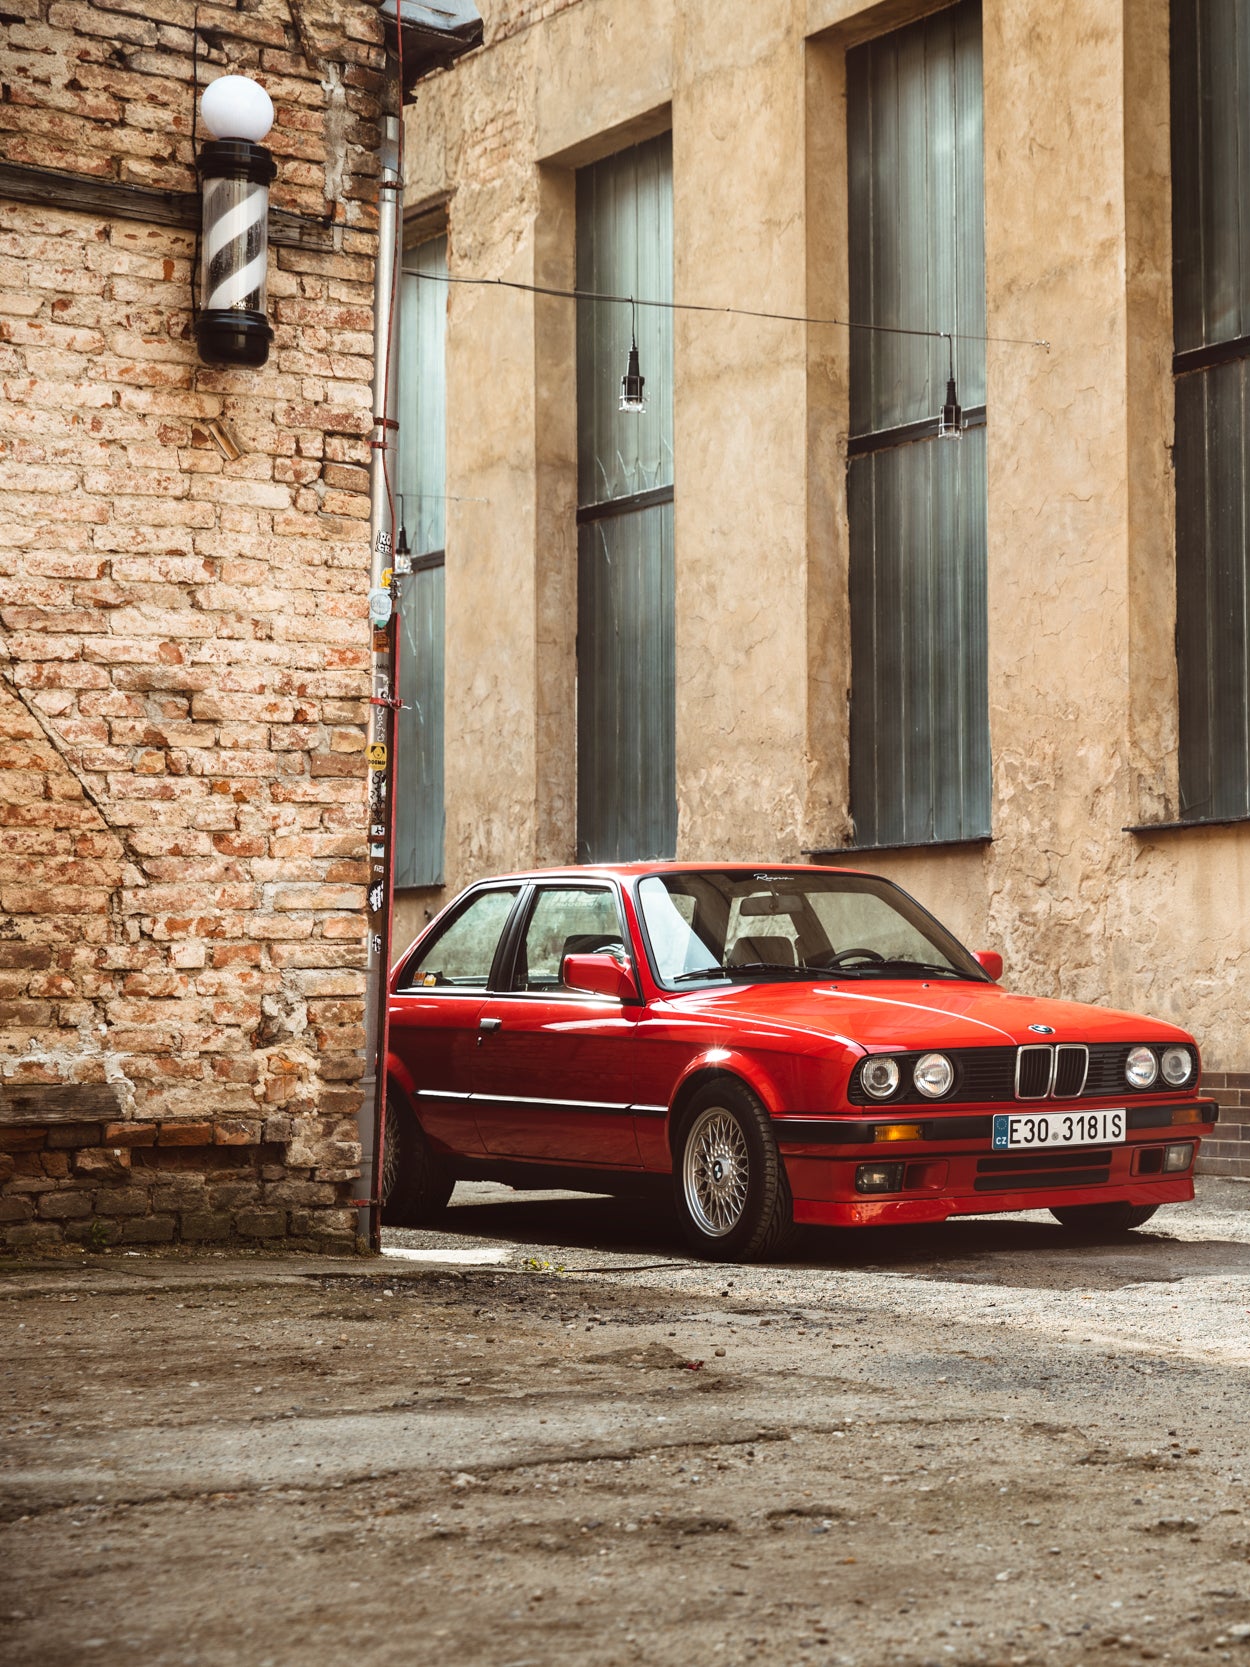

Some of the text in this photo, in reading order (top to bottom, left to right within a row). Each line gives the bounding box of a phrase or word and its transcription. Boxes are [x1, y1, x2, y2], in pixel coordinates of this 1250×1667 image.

[1009, 1114, 1122, 1144] E30 318IS
[995, 1137, 1007, 1145] CZ
